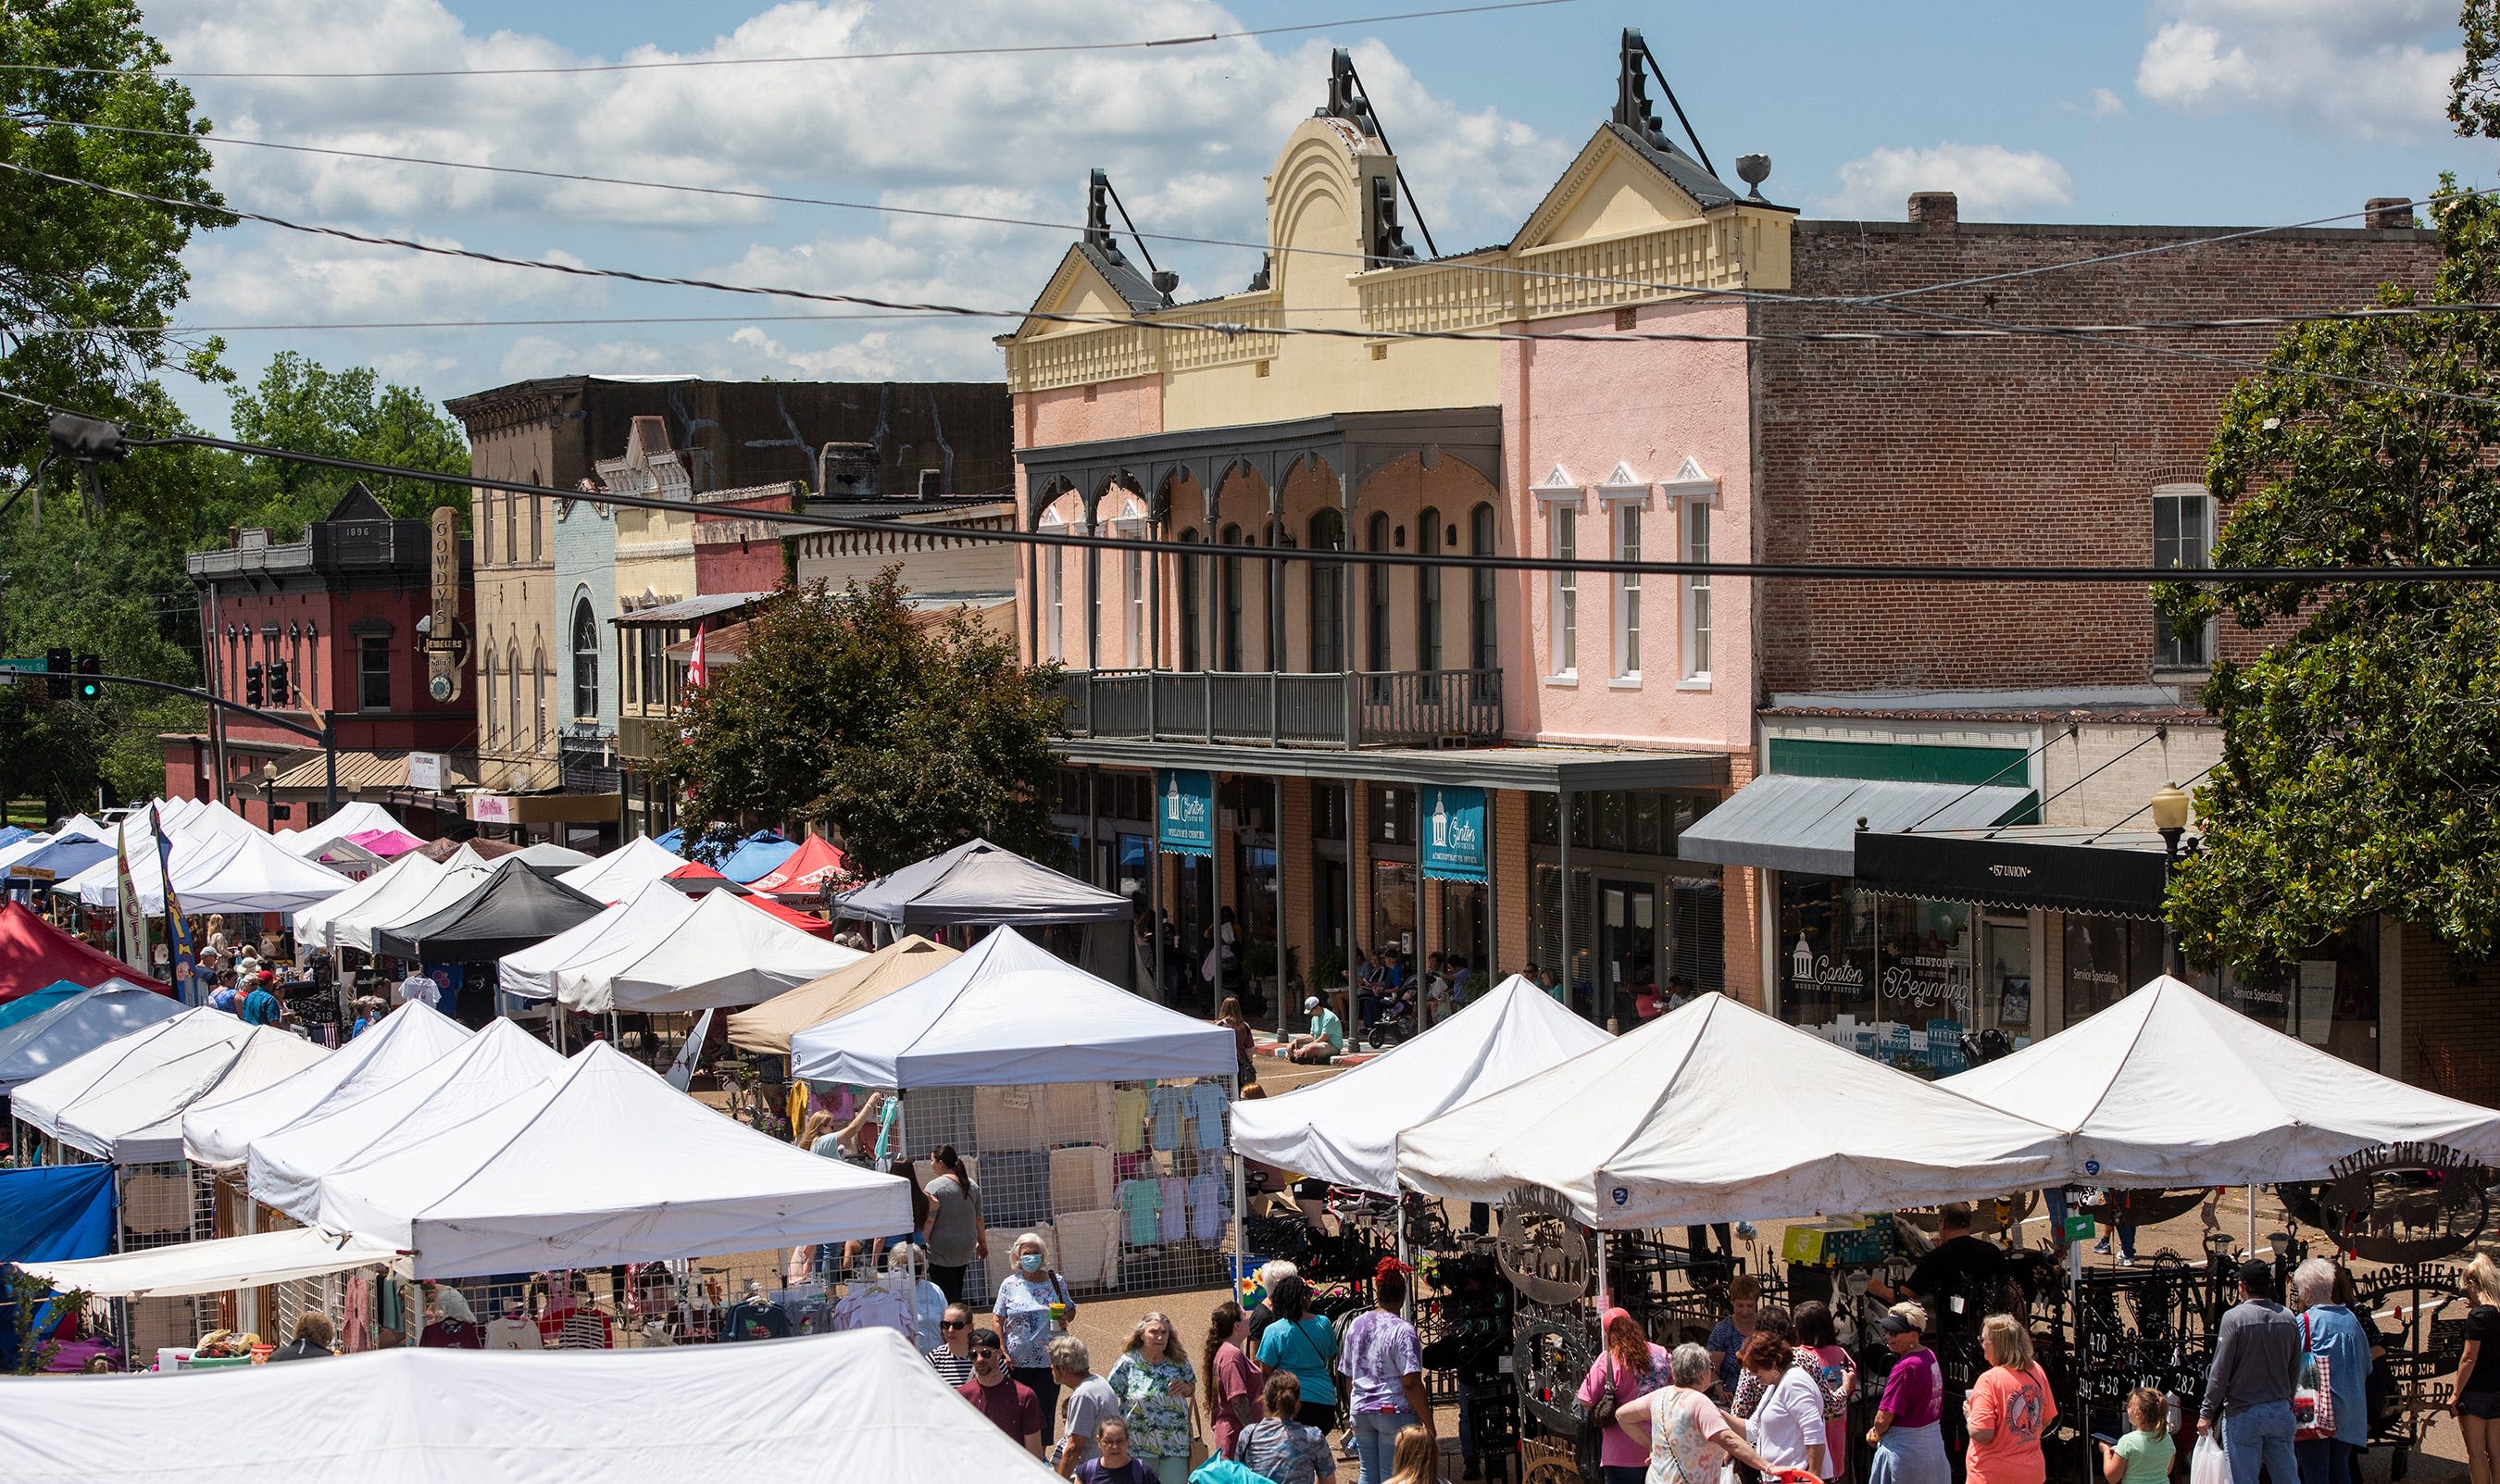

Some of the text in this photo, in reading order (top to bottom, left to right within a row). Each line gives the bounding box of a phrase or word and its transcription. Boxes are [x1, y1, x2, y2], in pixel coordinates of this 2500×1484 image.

[346, 527, 369, 536] 1896
[37, 663, 44, 671] St
[1448, 817, 1476, 849] Canton
[1994, 865, 2027, 877] 157 UNION
[1815, 954, 1864, 985] Canton
[1900, 956, 1955, 968] OUR HISTORY
[2074, 967, 2119, 984] Service Specialists
[1794, 982, 1821, 991] MUSEUM
[1832, 986, 1860, 994] HISTORY
[1882, 966, 1971, 1012] Beginning
[2232, 986, 2283, 1004] Service Specialists
[2329, 1143, 2387, 1181] LIVING
[2392, 1141, 2424, 1162] THE
[2089, 1332, 2107, 1353] 478
[1949, 1361, 1969, 1383] 1220
[2099, 1374, 2119, 1396] 438
[2175, 1372, 2195, 1396] 282
